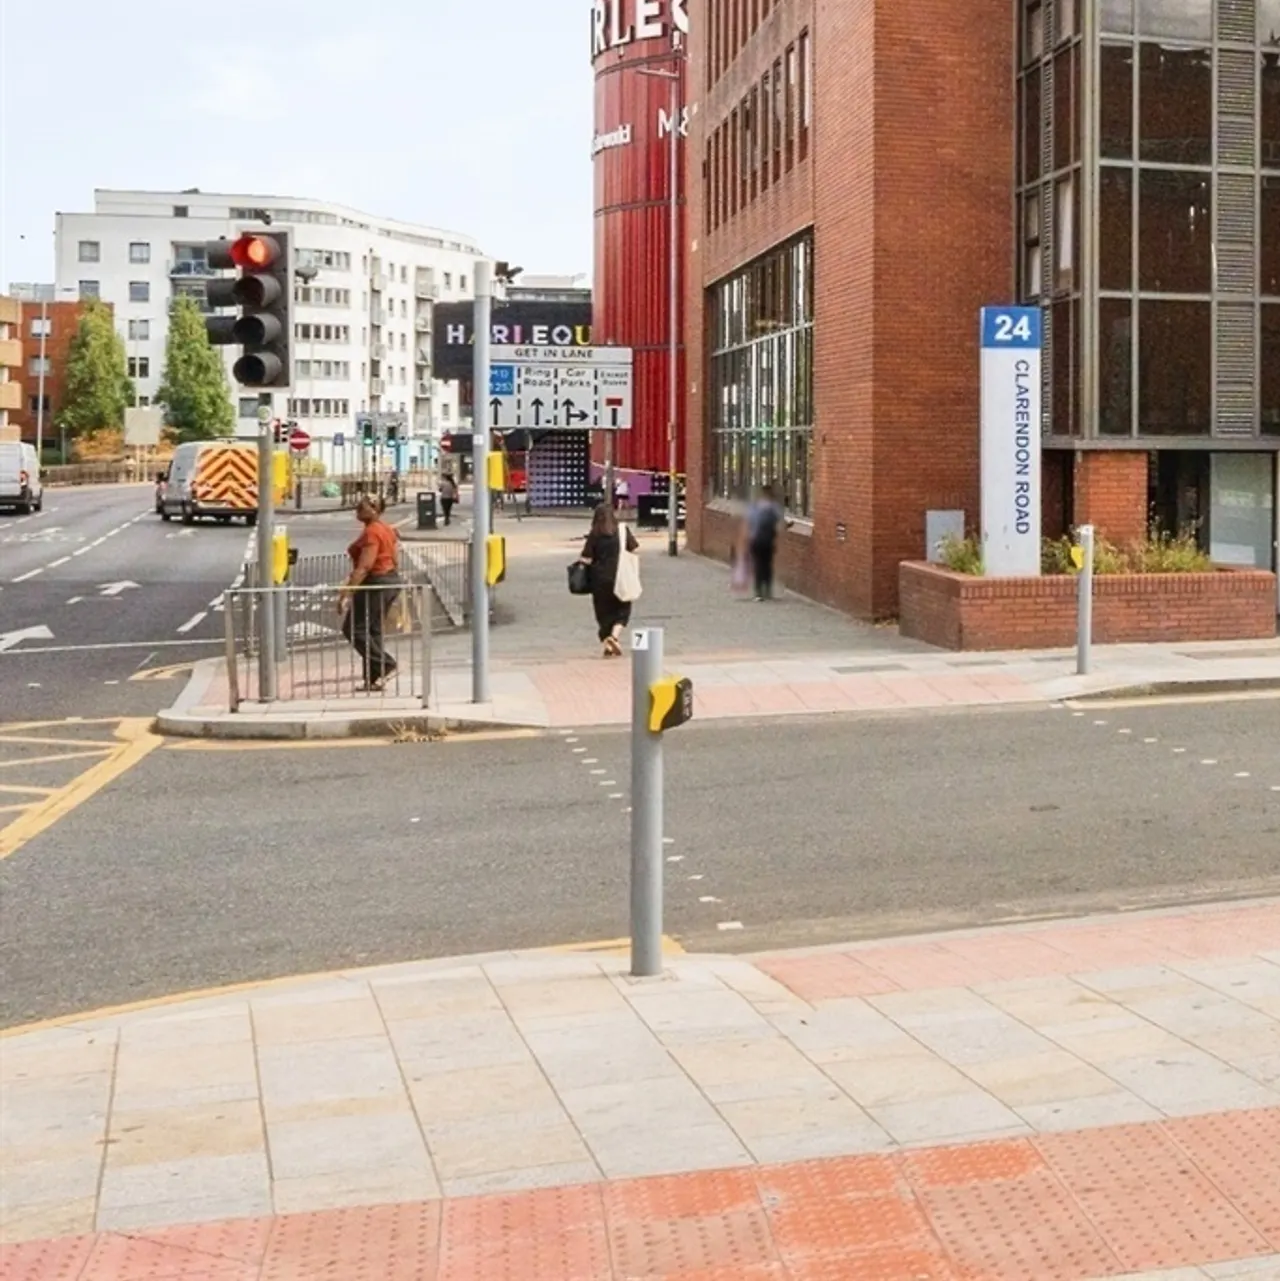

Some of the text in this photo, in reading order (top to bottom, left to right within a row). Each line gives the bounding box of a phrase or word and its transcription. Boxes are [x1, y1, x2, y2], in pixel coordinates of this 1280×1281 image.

[994, 315, 1032, 341] 24
[447, 324, 592, 345] HRLEQU
[514, 348, 594, 359] GET IN LANE
[524, 367, 551, 379] Ring
[566, 368, 586, 377] Car
[524, 378, 552, 387] Road
[560, 378, 591, 388] Parks
[1014, 358, 1031, 535] CLARENDON ROAD
[635, 633, 643, 646] 7
